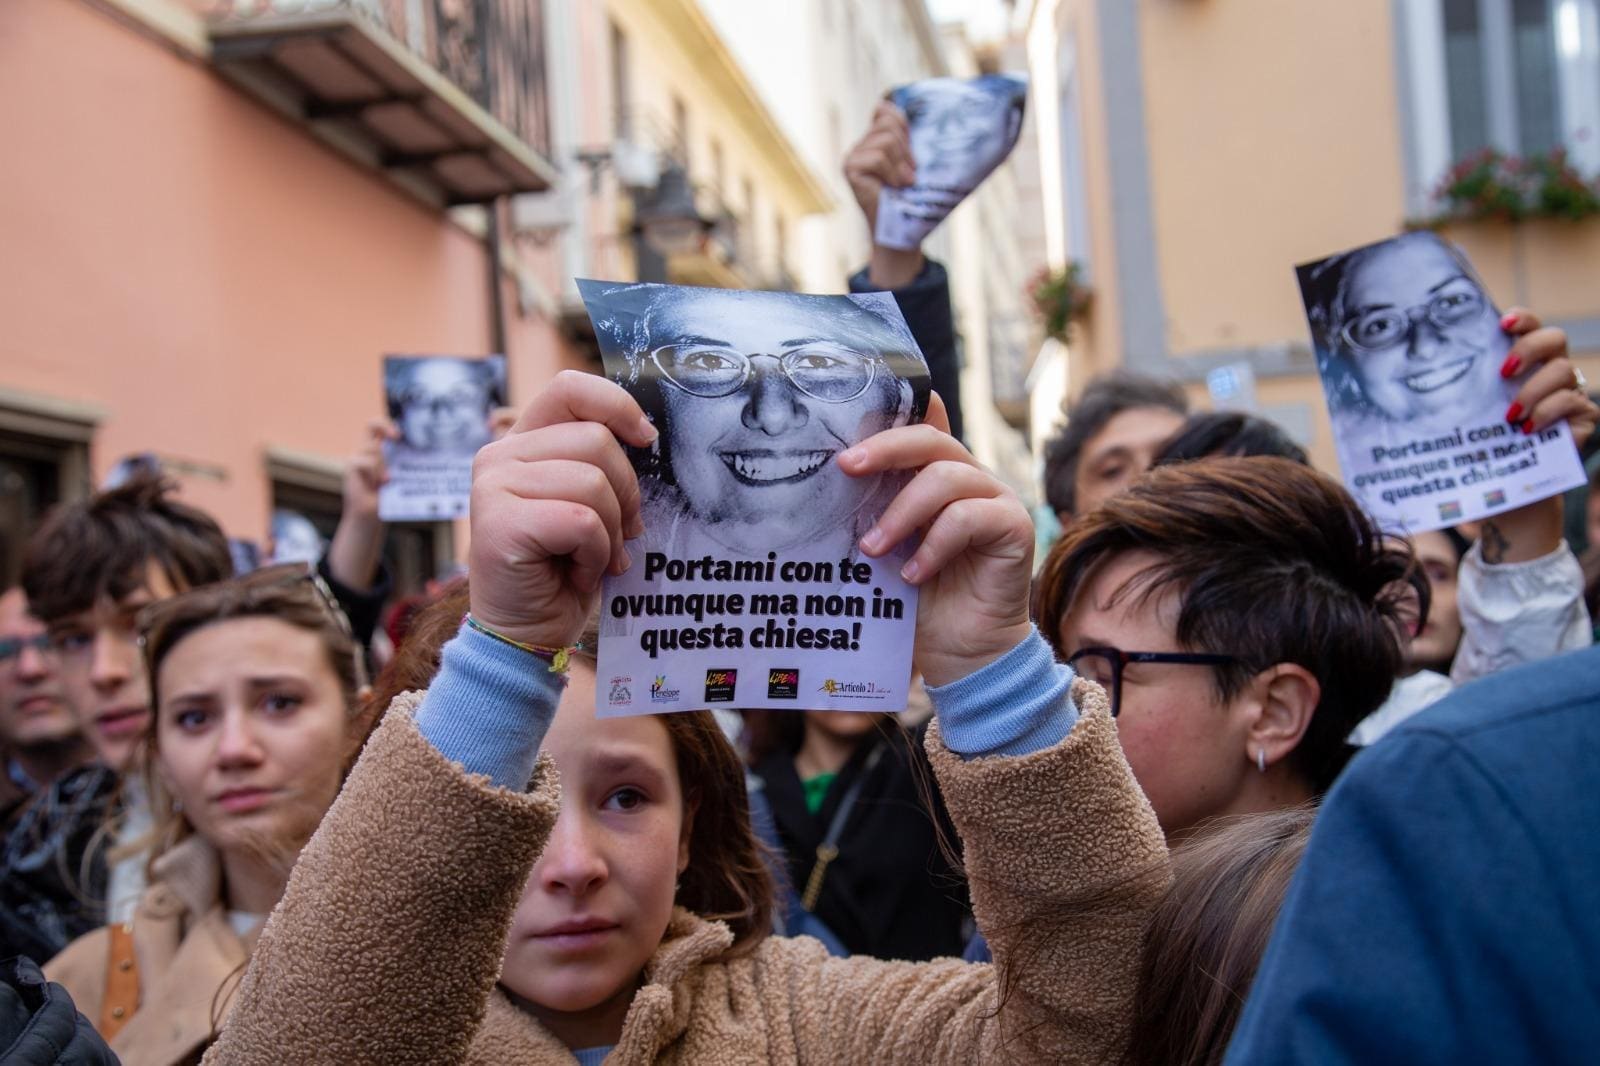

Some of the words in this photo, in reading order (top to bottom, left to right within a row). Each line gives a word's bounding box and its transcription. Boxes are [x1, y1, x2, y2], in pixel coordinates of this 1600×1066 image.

[1371, 427, 1464, 463] Portami
[1467, 422, 1506, 444] con
[1353, 456, 1449, 488] ovunque
[1453, 449, 1489, 467] ma
[1492, 439, 1536, 460] non
[1381, 475, 1457, 504] questa
[1461, 452, 1539, 486] chiesa!
[644, 551, 777, 582] Portami
[780, 561, 833, 583] con
[839, 557, 872, 584] te
[610, 592, 752, 622] ovunque
[750, 593, 798, 616] ma
[804, 594, 865, 618] non
[872, 587, 904, 619] in
[640, 623, 745, 658] questa
[749, 617, 862, 651] chiesa!
